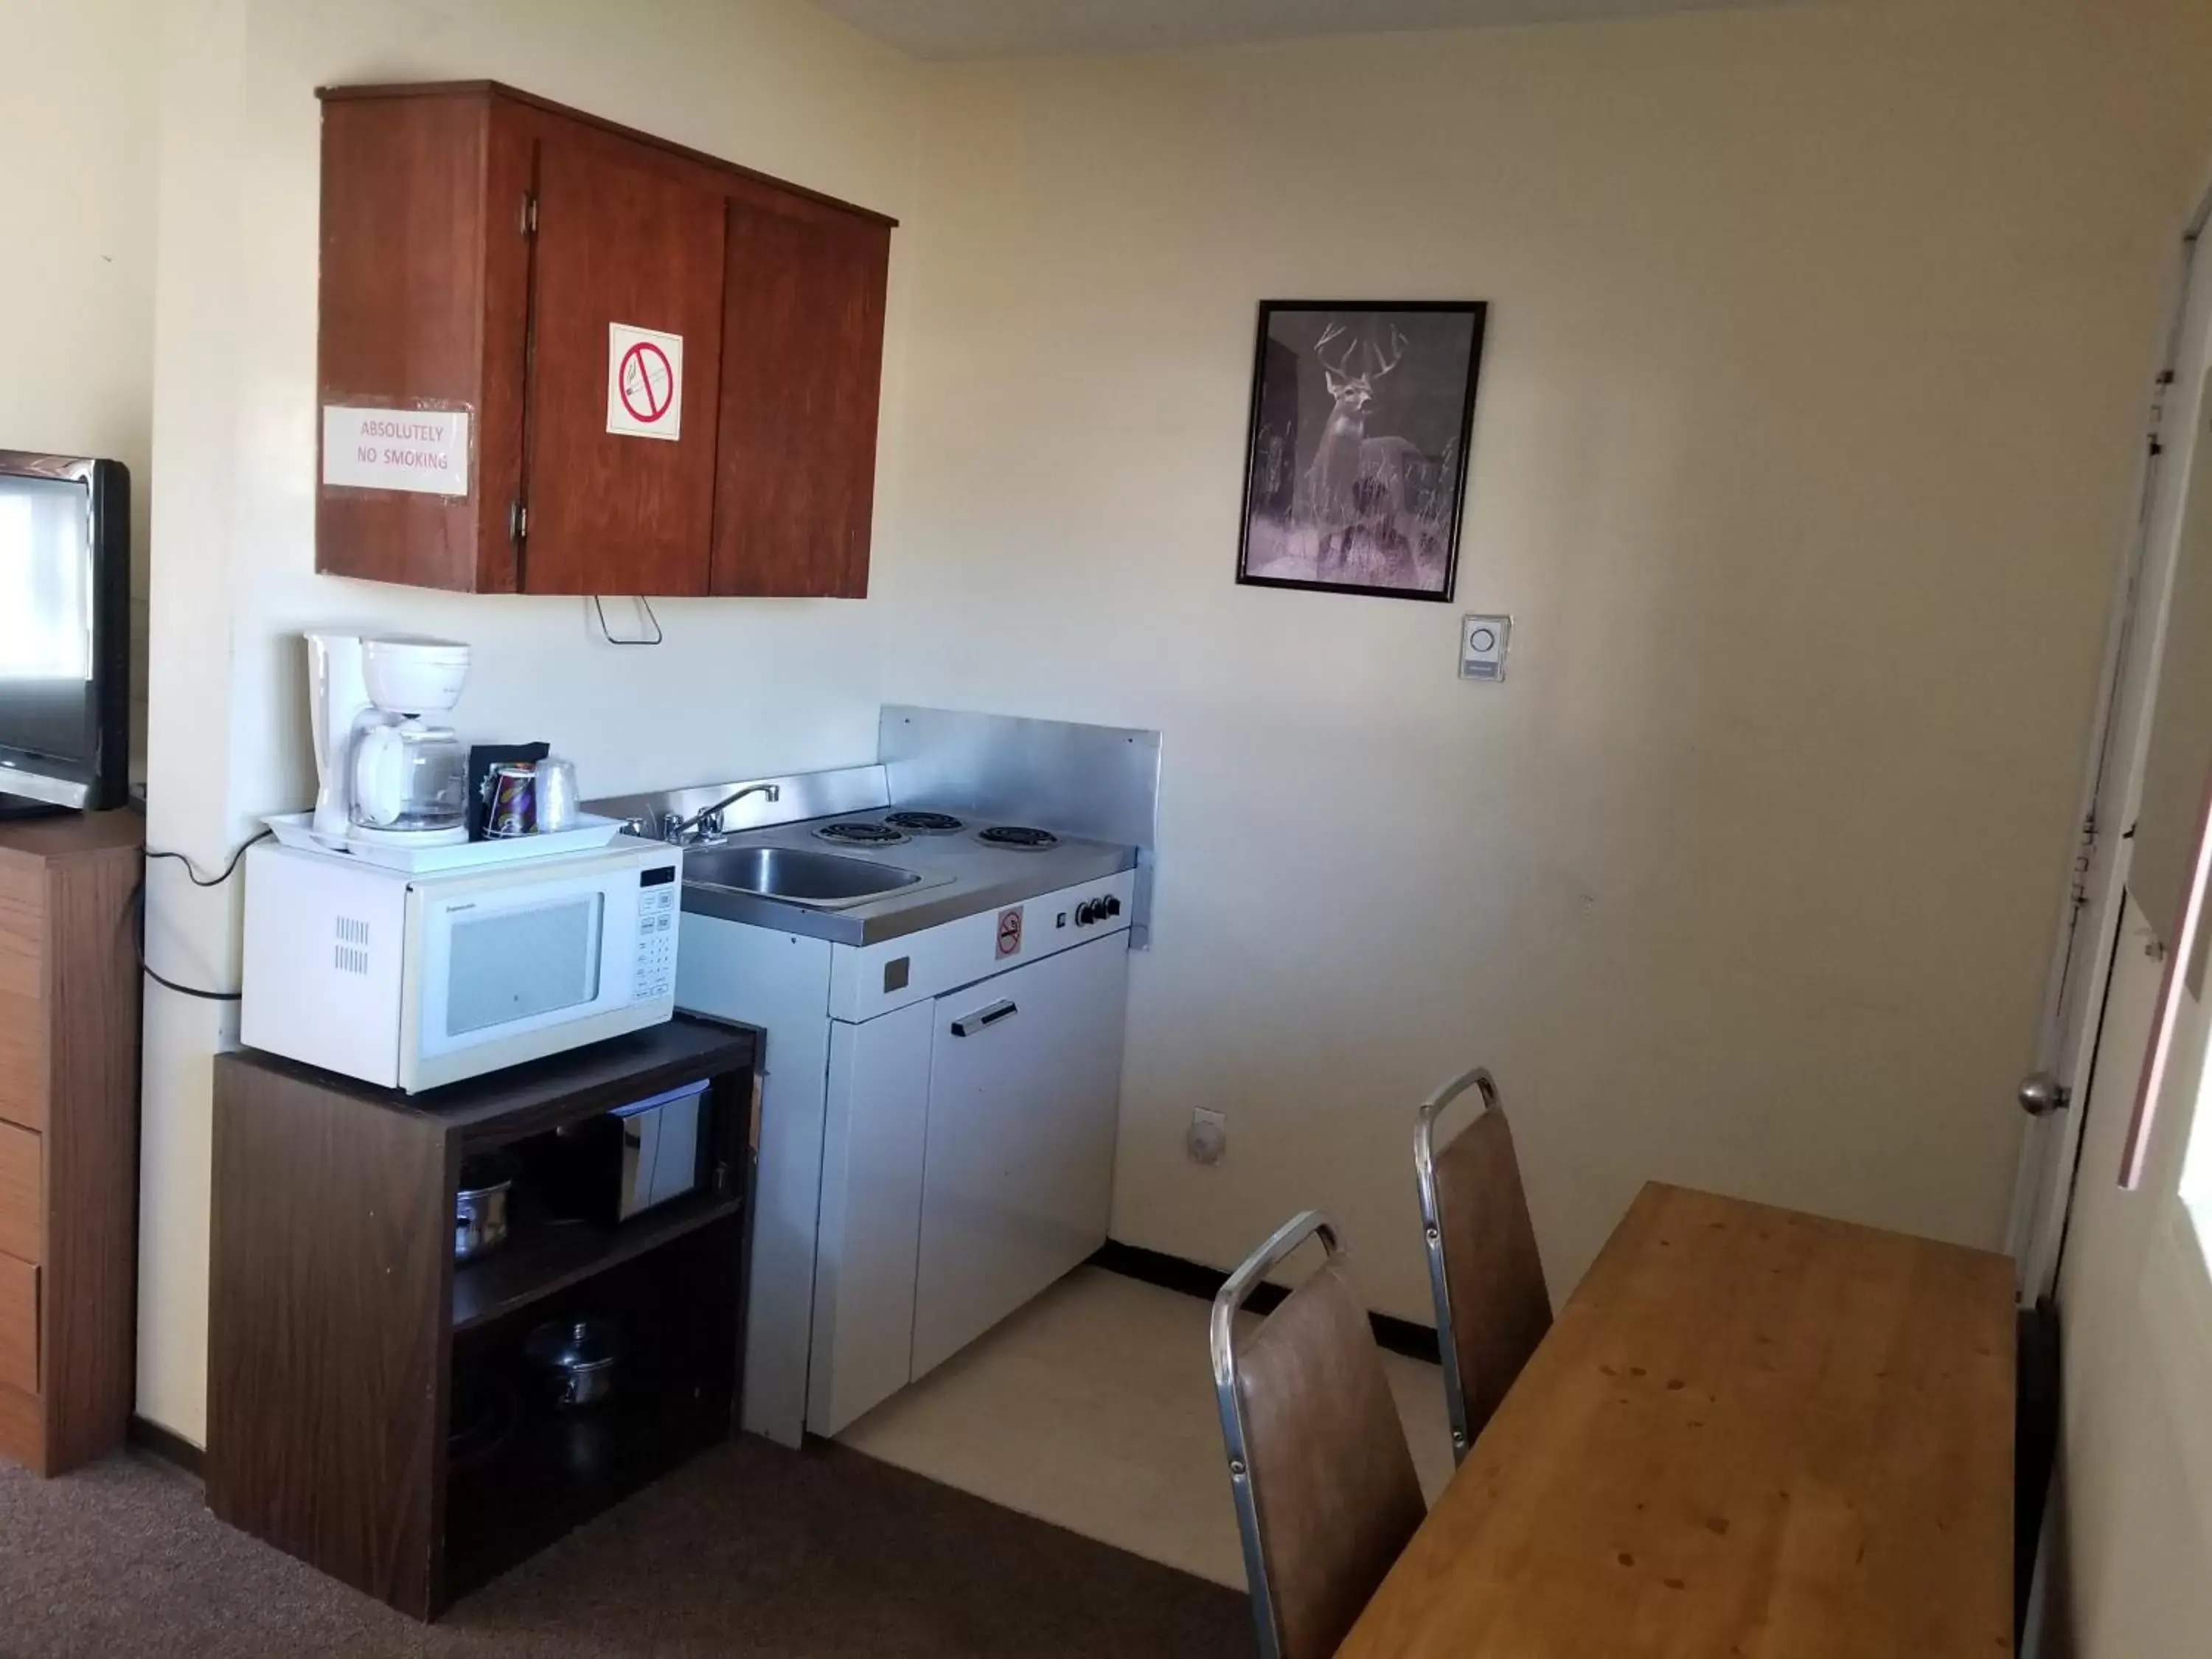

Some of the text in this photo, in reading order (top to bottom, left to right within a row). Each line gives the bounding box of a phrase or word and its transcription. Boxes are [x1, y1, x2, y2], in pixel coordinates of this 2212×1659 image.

[361, 420, 444, 442] ABSOLUTELY
[358, 445, 448, 470] NO SMOKING
